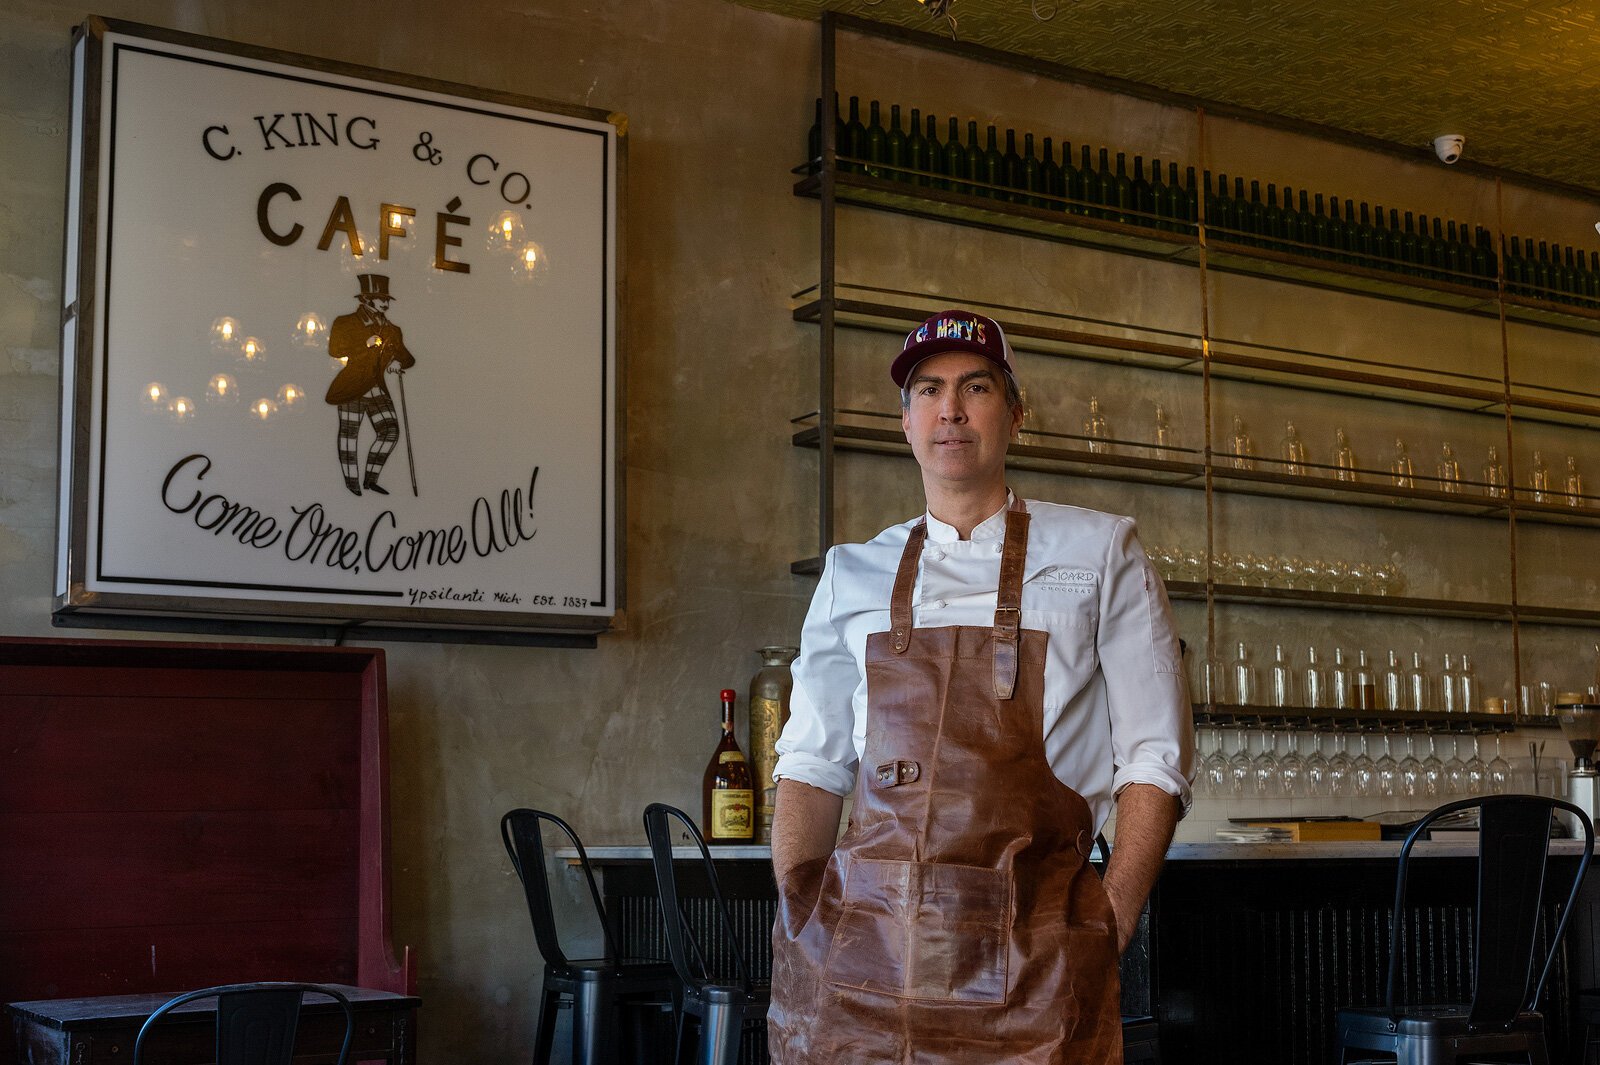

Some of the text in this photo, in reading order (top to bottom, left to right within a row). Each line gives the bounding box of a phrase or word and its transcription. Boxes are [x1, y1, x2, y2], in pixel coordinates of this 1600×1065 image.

[202, 112, 532, 210] C. KING & CO.
[256, 182, 471, 275] CAFÉ
[936, 316, 986, 345] Mary's
[161, 454, 540, 575] Come One, Come All!
[1039, 565, 1095, 581] RICARD
[408, 587, 485, 606] Ypsilanti
[563, 596, 588, 609] 1837
[1040, 586, 1092, 594] CHOCOLAT
